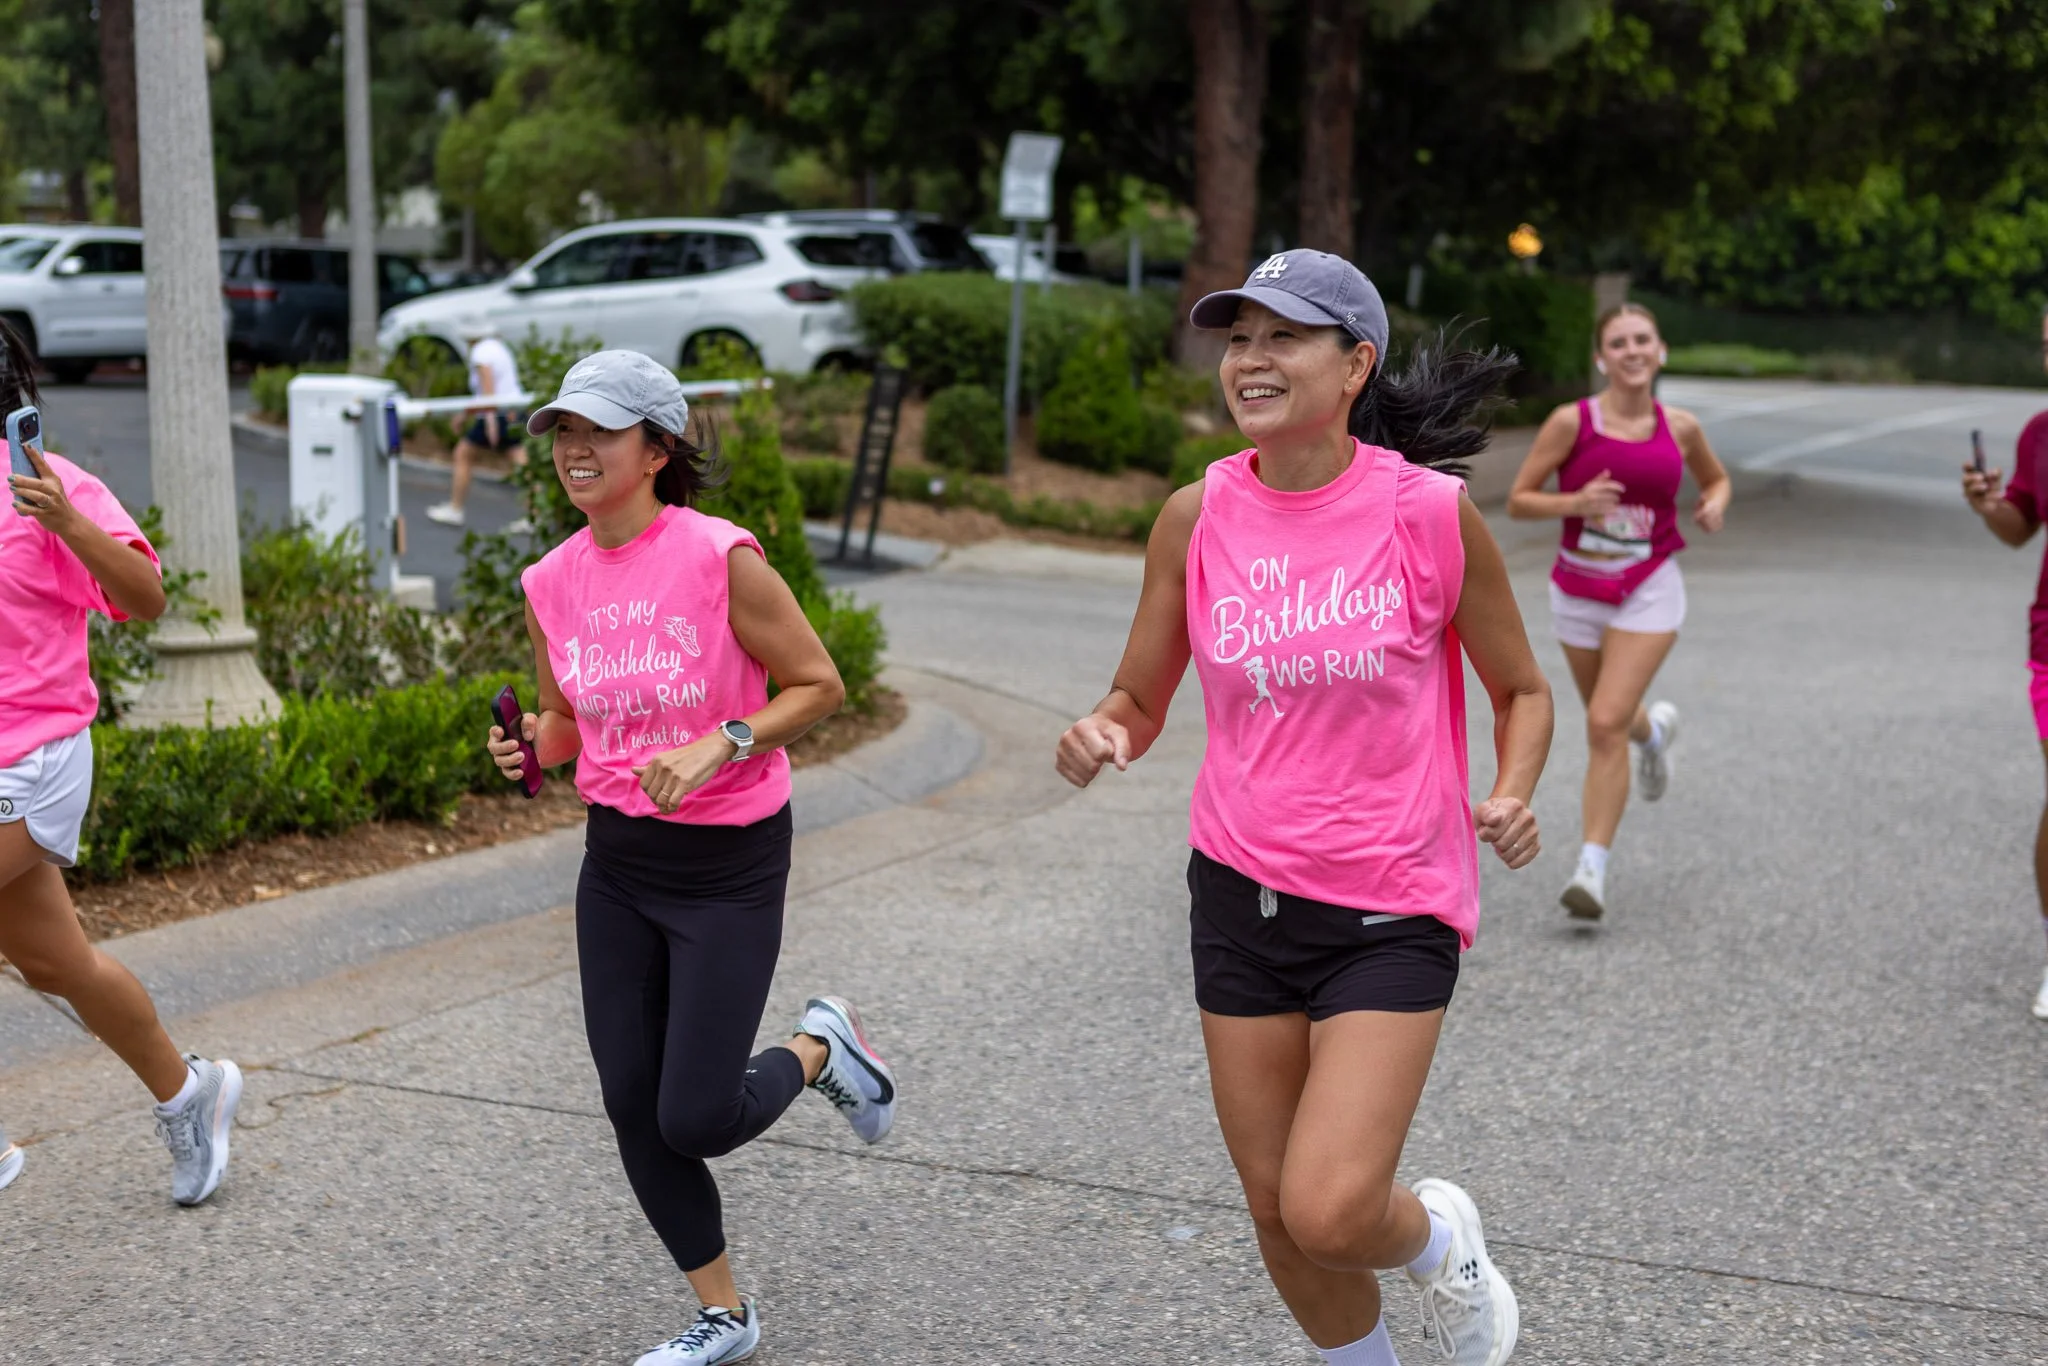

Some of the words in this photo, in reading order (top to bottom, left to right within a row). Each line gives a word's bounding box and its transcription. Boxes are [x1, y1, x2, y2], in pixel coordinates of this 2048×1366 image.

[1255, 253, 1289, 280] LA
[1249, 554, 1290, 592] ON
[626, 599, 657, 627] MY
[1211, 566, 1405, 664] Birthdays
[584, 633, 685, 687] Birthday
[1323, 646, 1386, 686] RUN
[576, 694, 609, 721] AND
[656, 678, 706, 713] RUN
[612, 725, 627, 754] I
[631, 724, 672, 749] want
[672, 725, 692, 746] to
